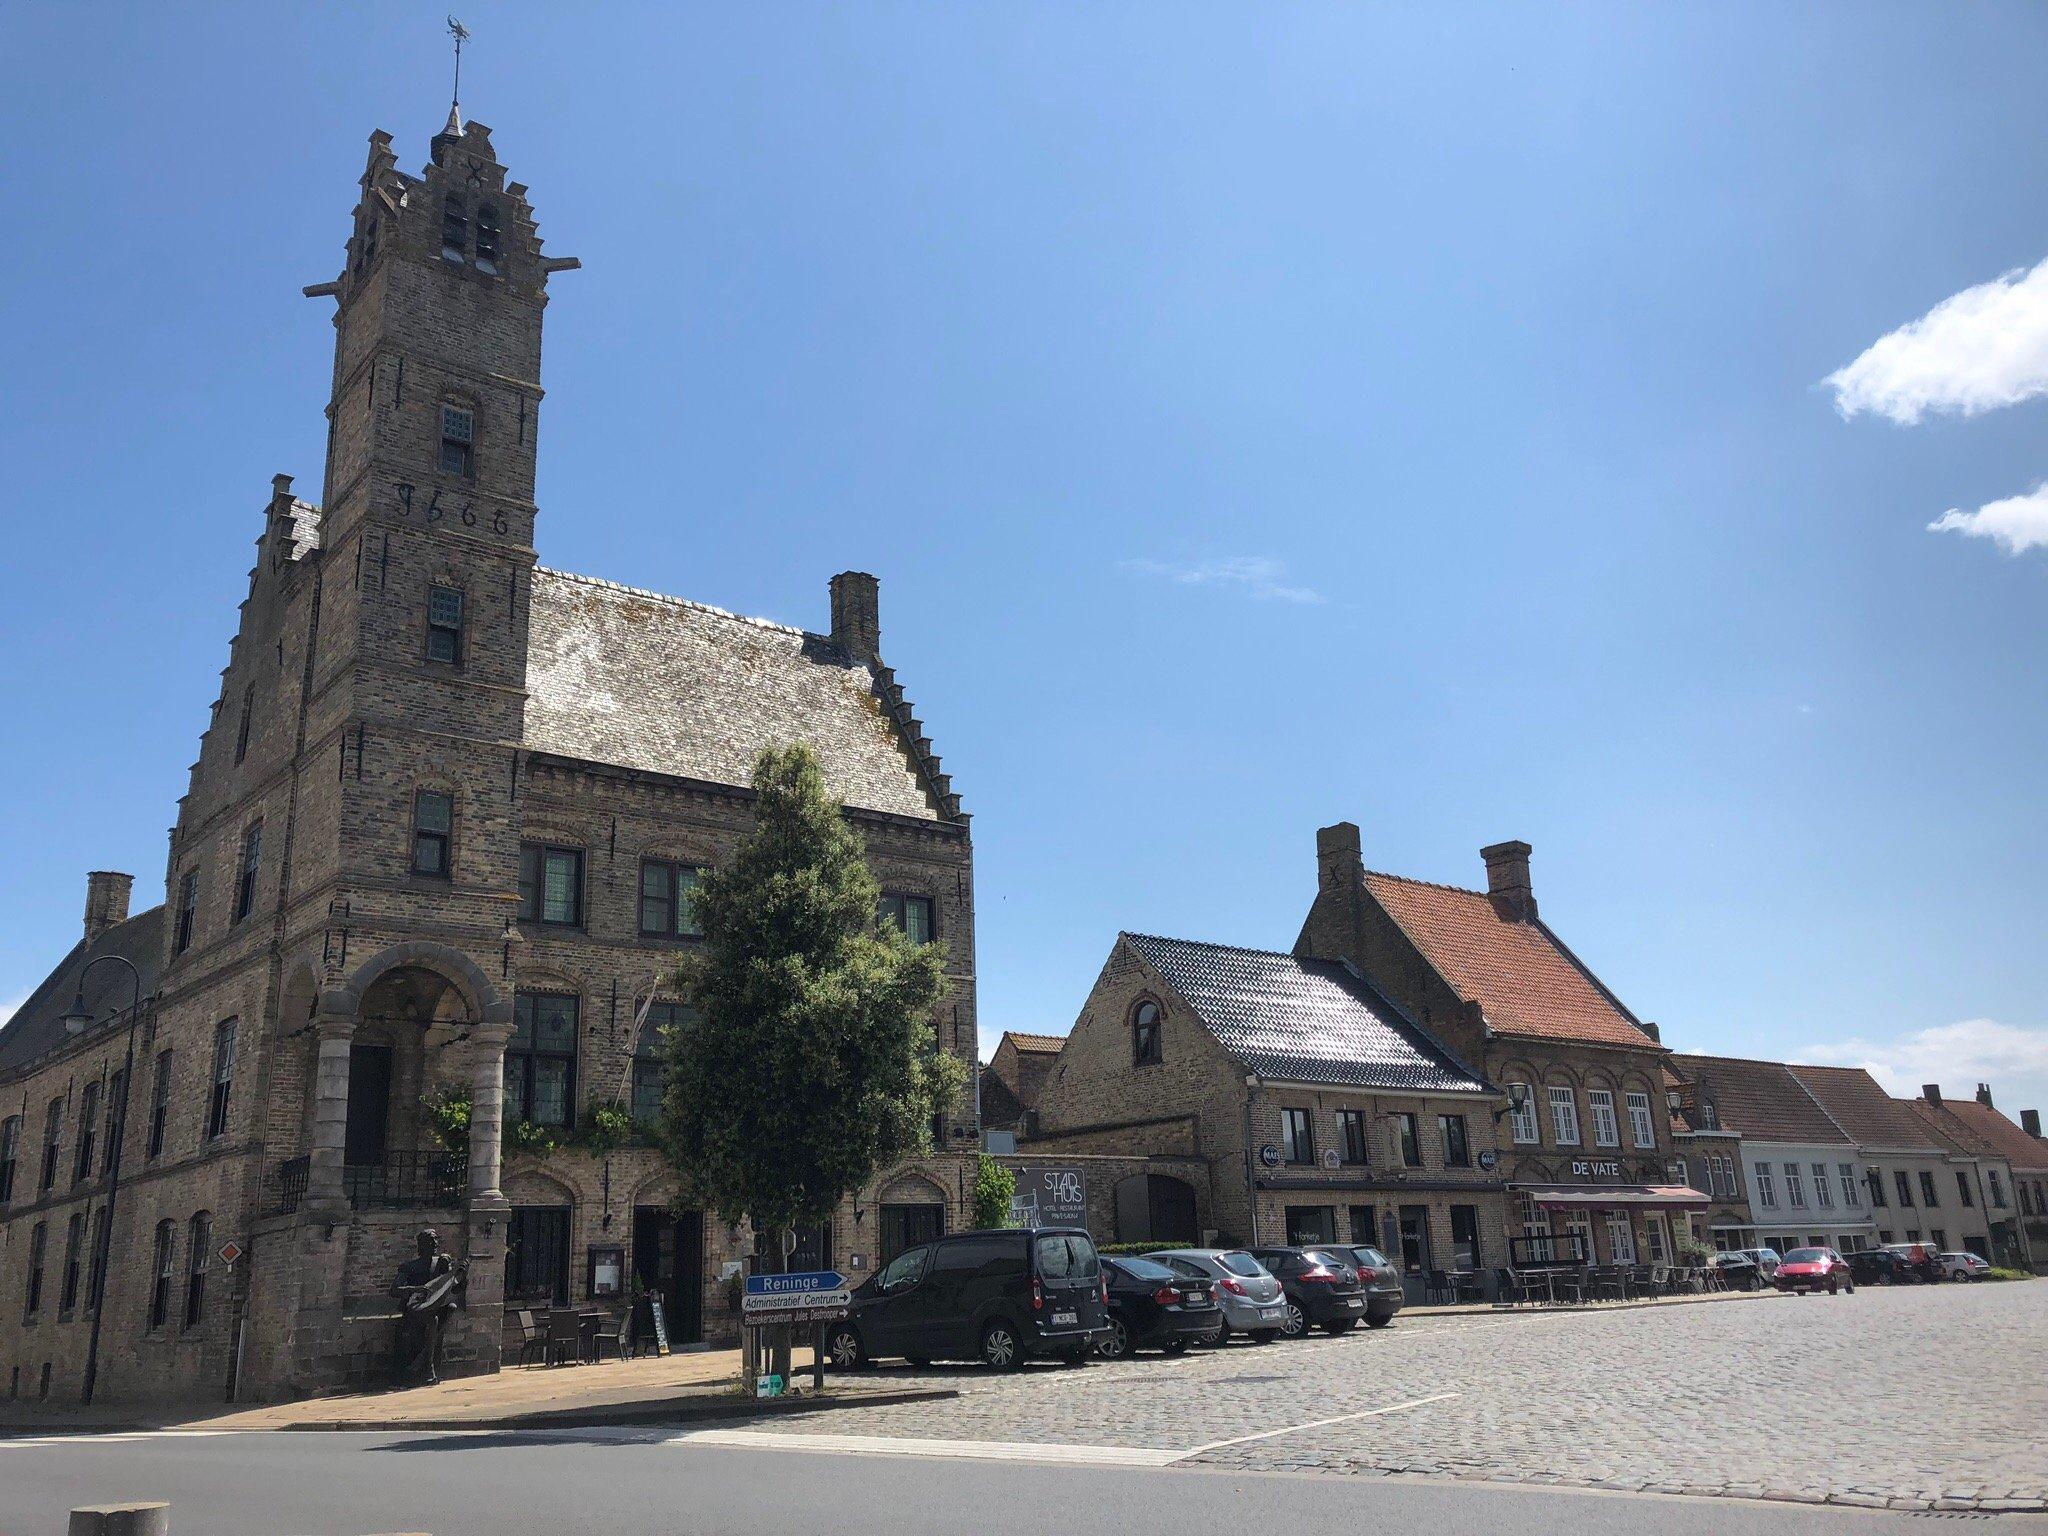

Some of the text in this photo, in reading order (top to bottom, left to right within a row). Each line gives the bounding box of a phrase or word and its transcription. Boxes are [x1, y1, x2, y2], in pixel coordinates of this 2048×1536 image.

[1572, 1161, 1620, 1176] DE VATE
[1044, 1172, 1078, 1190] STAD
[1053, 1185, 1083, 1202] HUIS
[763, 1277, 819, 1291] Reninge
[745, 1294, 838, 1309] Administratief Centrum
[794, 1310, 808, 1321] Jules
